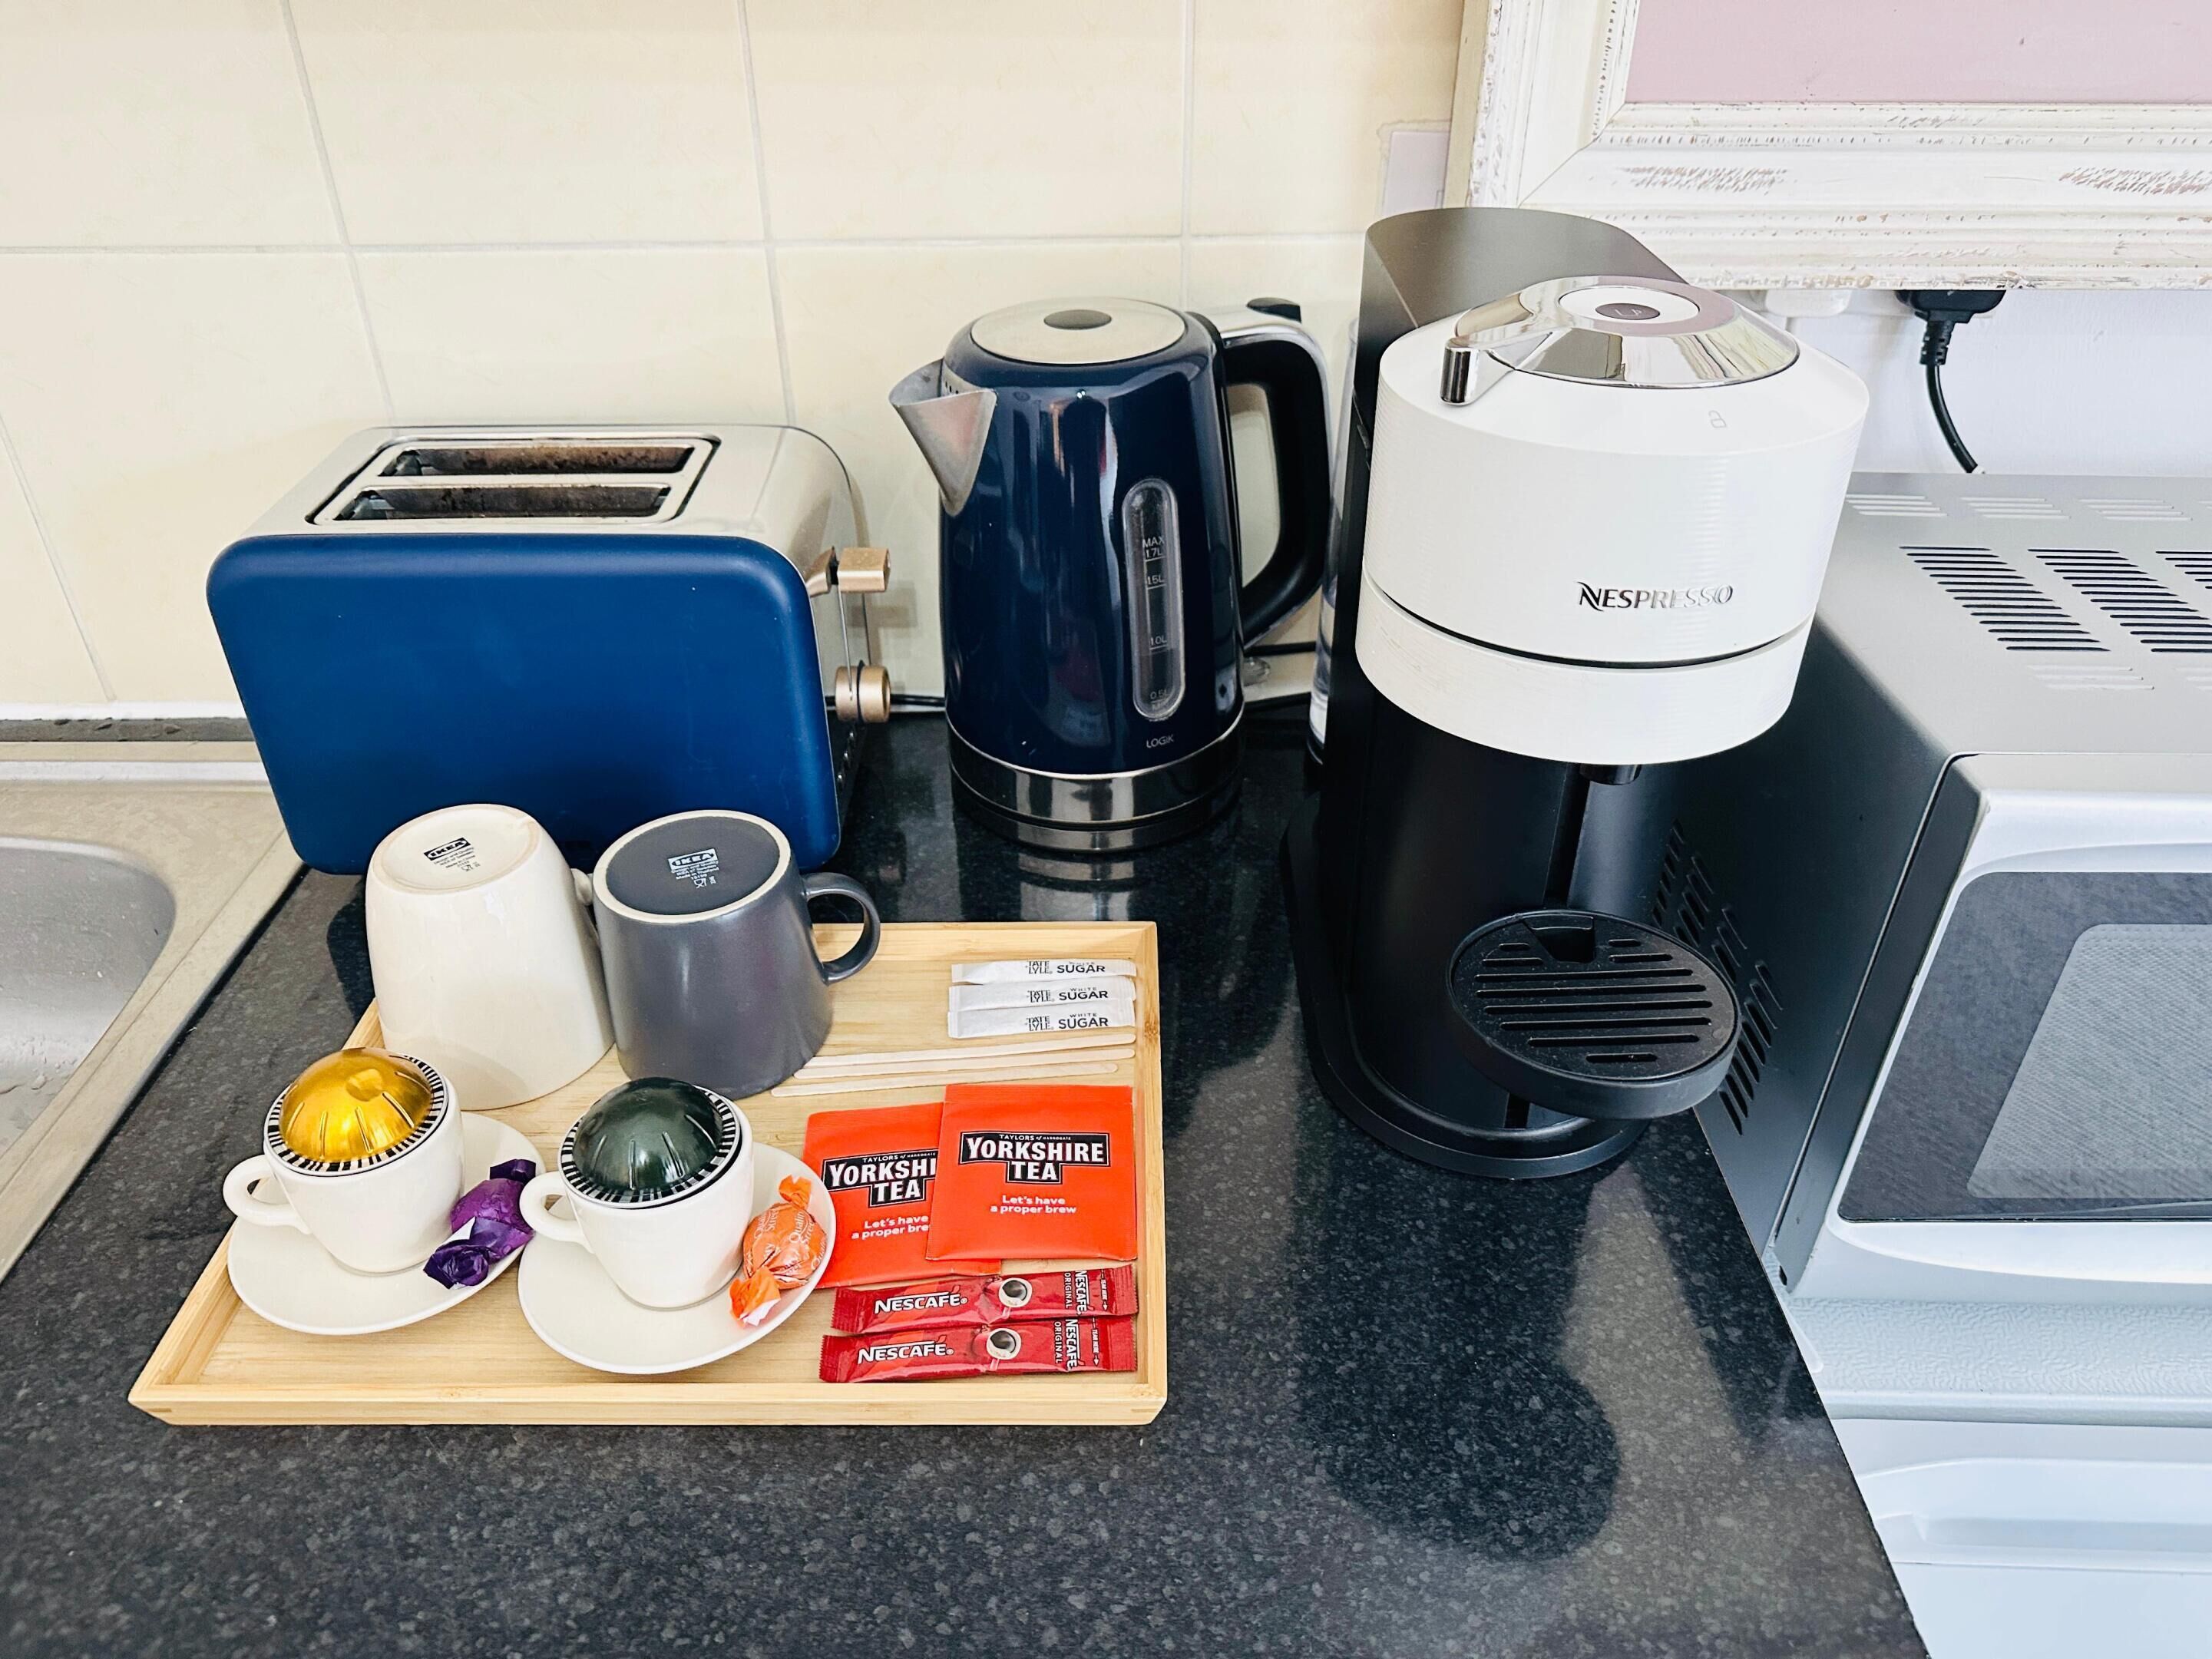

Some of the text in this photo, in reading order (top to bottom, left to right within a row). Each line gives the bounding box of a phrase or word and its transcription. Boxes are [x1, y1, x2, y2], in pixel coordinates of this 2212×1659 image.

[1142, 536, 1165, 548] MAX
[1576, 581, 1734, 612] NESPRESSO
[1146, 734, 1174, 749] LOGIK
[430, 841, 465, 857] IKEA
[676, 852, 712, 866] IKEA
[1056, 964, 1106, 973] SUGAR
[1059, 990, 1109, 1001] SUGAR
[1058, 1017, 1109, 1029] SUGAR
[967, 1136, 1104, 1162] YORKSHIRE
[861, 1154, 898, 1163] TAYLORS
[828, 1158, 937, 1187] YORKSHI
[1010, 1161, 1058, 1180] TEA
[874, 1179, 921, 1202] TEA
[1002, 1195, 1066, 1205] Let's have
[1000, 1205, 1043, 1215] proper
[1044, 1205, 1077, 1214] brew
[864, 1215, 929, 1229] Let's have
[801, 1221, 815, 1244] Stree
[861, 1225, 906, 1241] proper
[907, 1224, 931, 1234] bre
[1064, 1272, 1073, 1309] ORIGINAL
[874, 1285, 961, 1314] NESCAFÉ
[857, 1335, 947, 1365] NESCAFÉ
[1054, 1321, 1063, 1363] ORIGINAL
